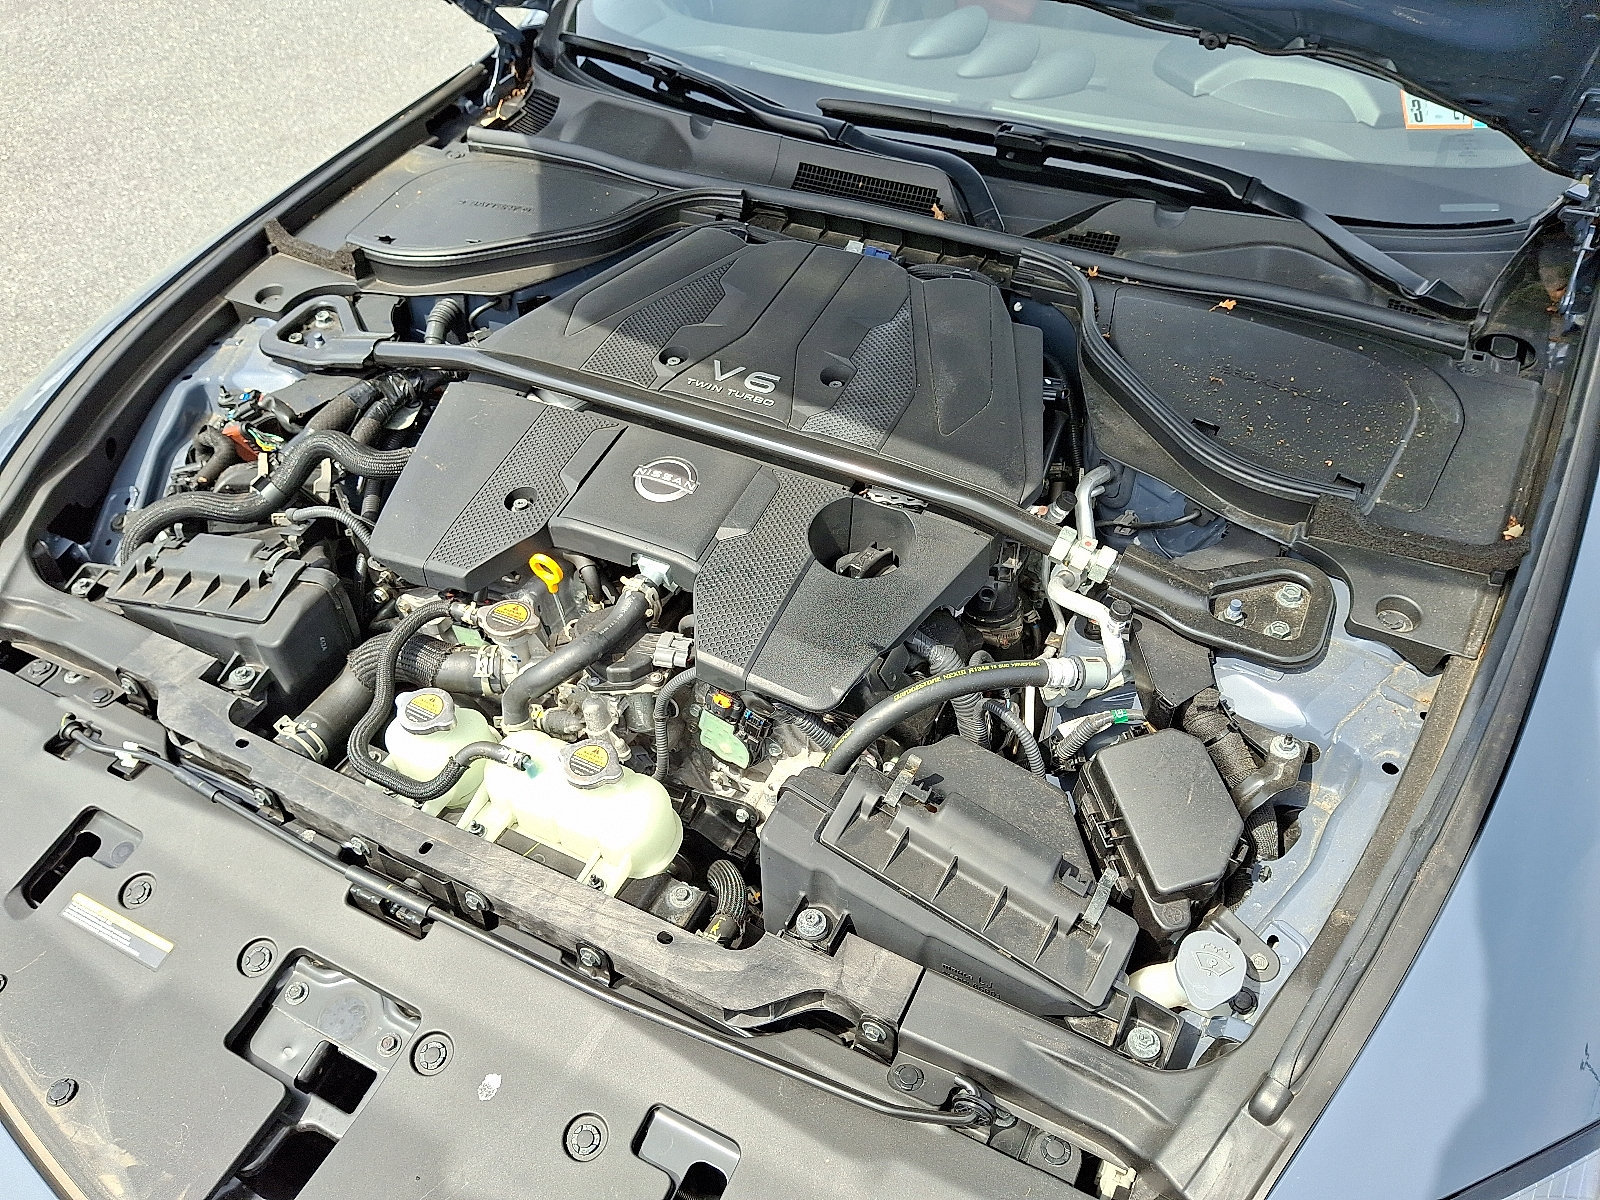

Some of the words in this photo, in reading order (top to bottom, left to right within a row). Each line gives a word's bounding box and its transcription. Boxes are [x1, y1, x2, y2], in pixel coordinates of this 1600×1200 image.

[687, 377, 723, 394] TWIN
[728, 388, 775, 407] TURBO
[713, 359, 782, 395] V6
[634, 467, 698, 493] NISSAN
